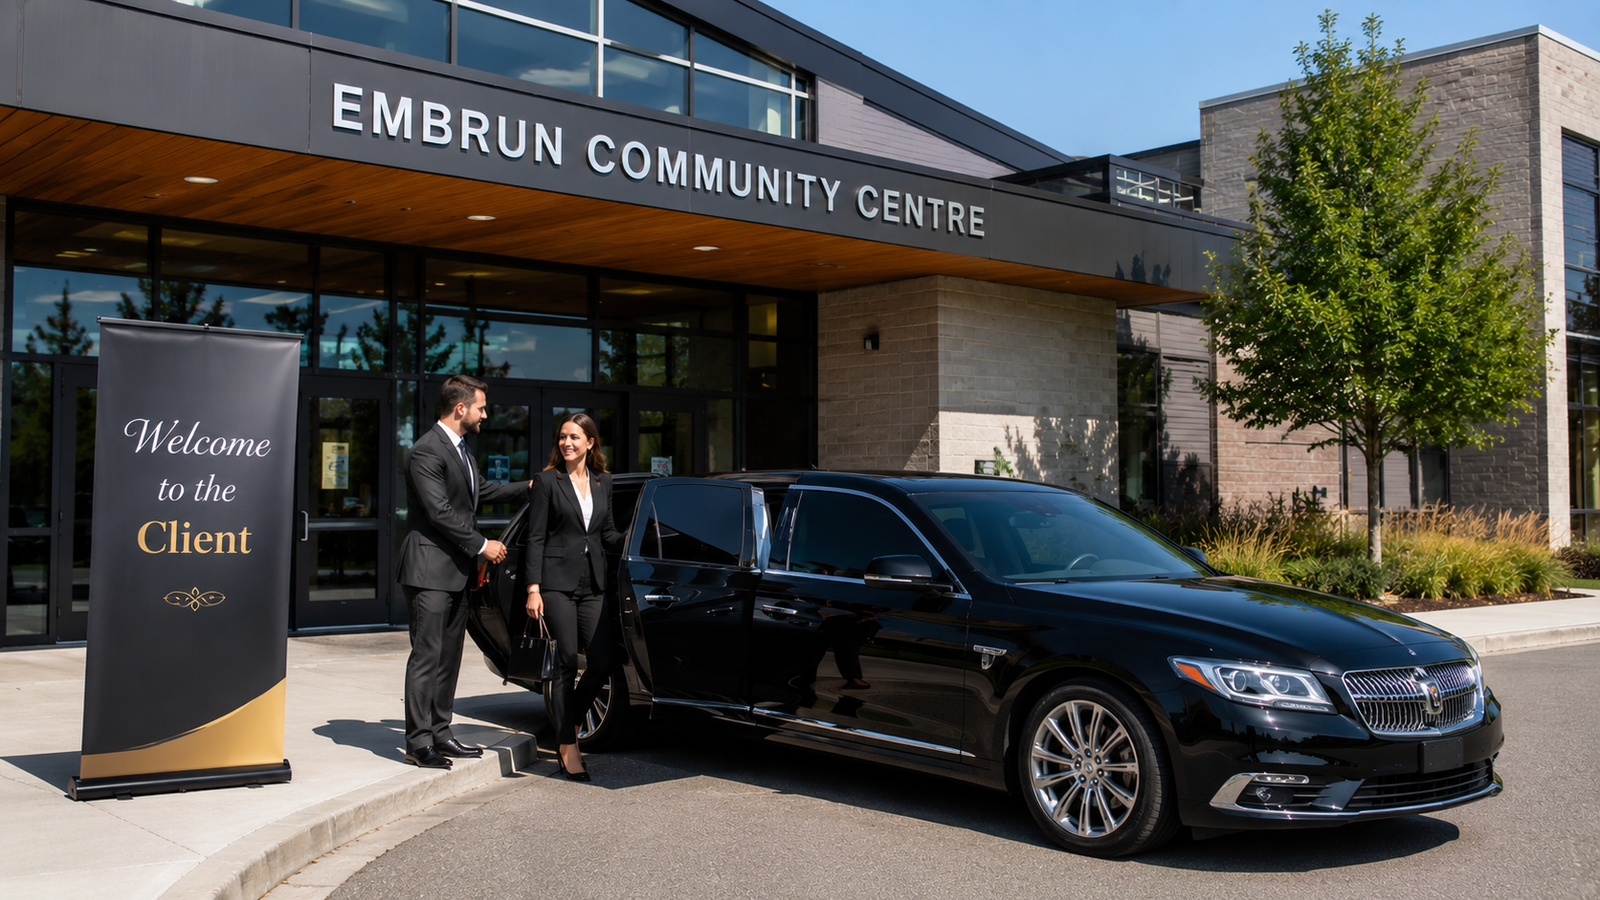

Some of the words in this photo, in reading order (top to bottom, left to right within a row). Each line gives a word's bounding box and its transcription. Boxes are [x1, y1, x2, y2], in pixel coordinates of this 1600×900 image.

[333, 83, 564, 166] EMBRUN
[587, 134, 841, 212] COMMUNITY
[857, 185, 986, 238] CENTRE
[124, 418, 272, 458] Welcome
[158, 478, 185, 502] to
[194, 473, 237, 502] the
[137, 520, 253, 555] Client
